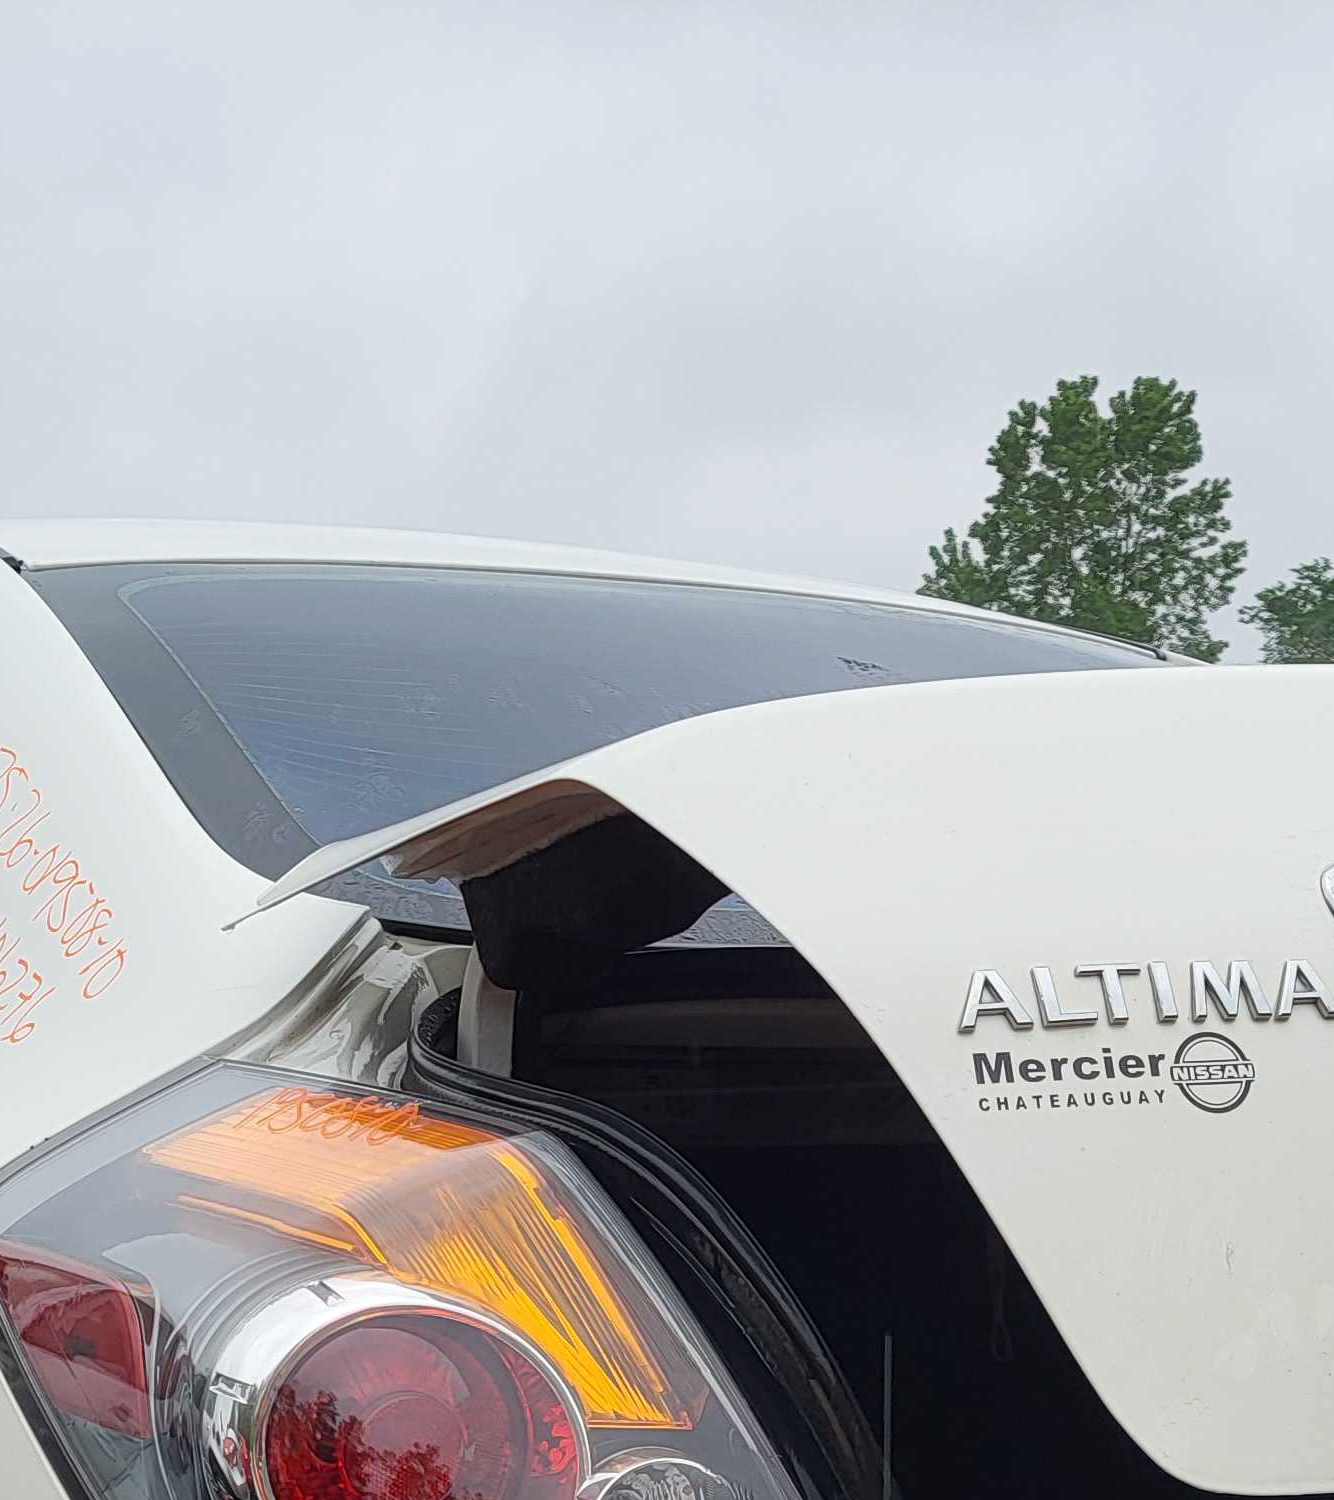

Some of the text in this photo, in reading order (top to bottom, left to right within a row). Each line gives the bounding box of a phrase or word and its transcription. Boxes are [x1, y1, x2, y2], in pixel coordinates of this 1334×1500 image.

[972, 1047, 1166, 1085] Mercier
[1170, 1062, 1255, 1083] NISSAN
[978, 1088, 1166, 1113] CHATEAUGUAY
